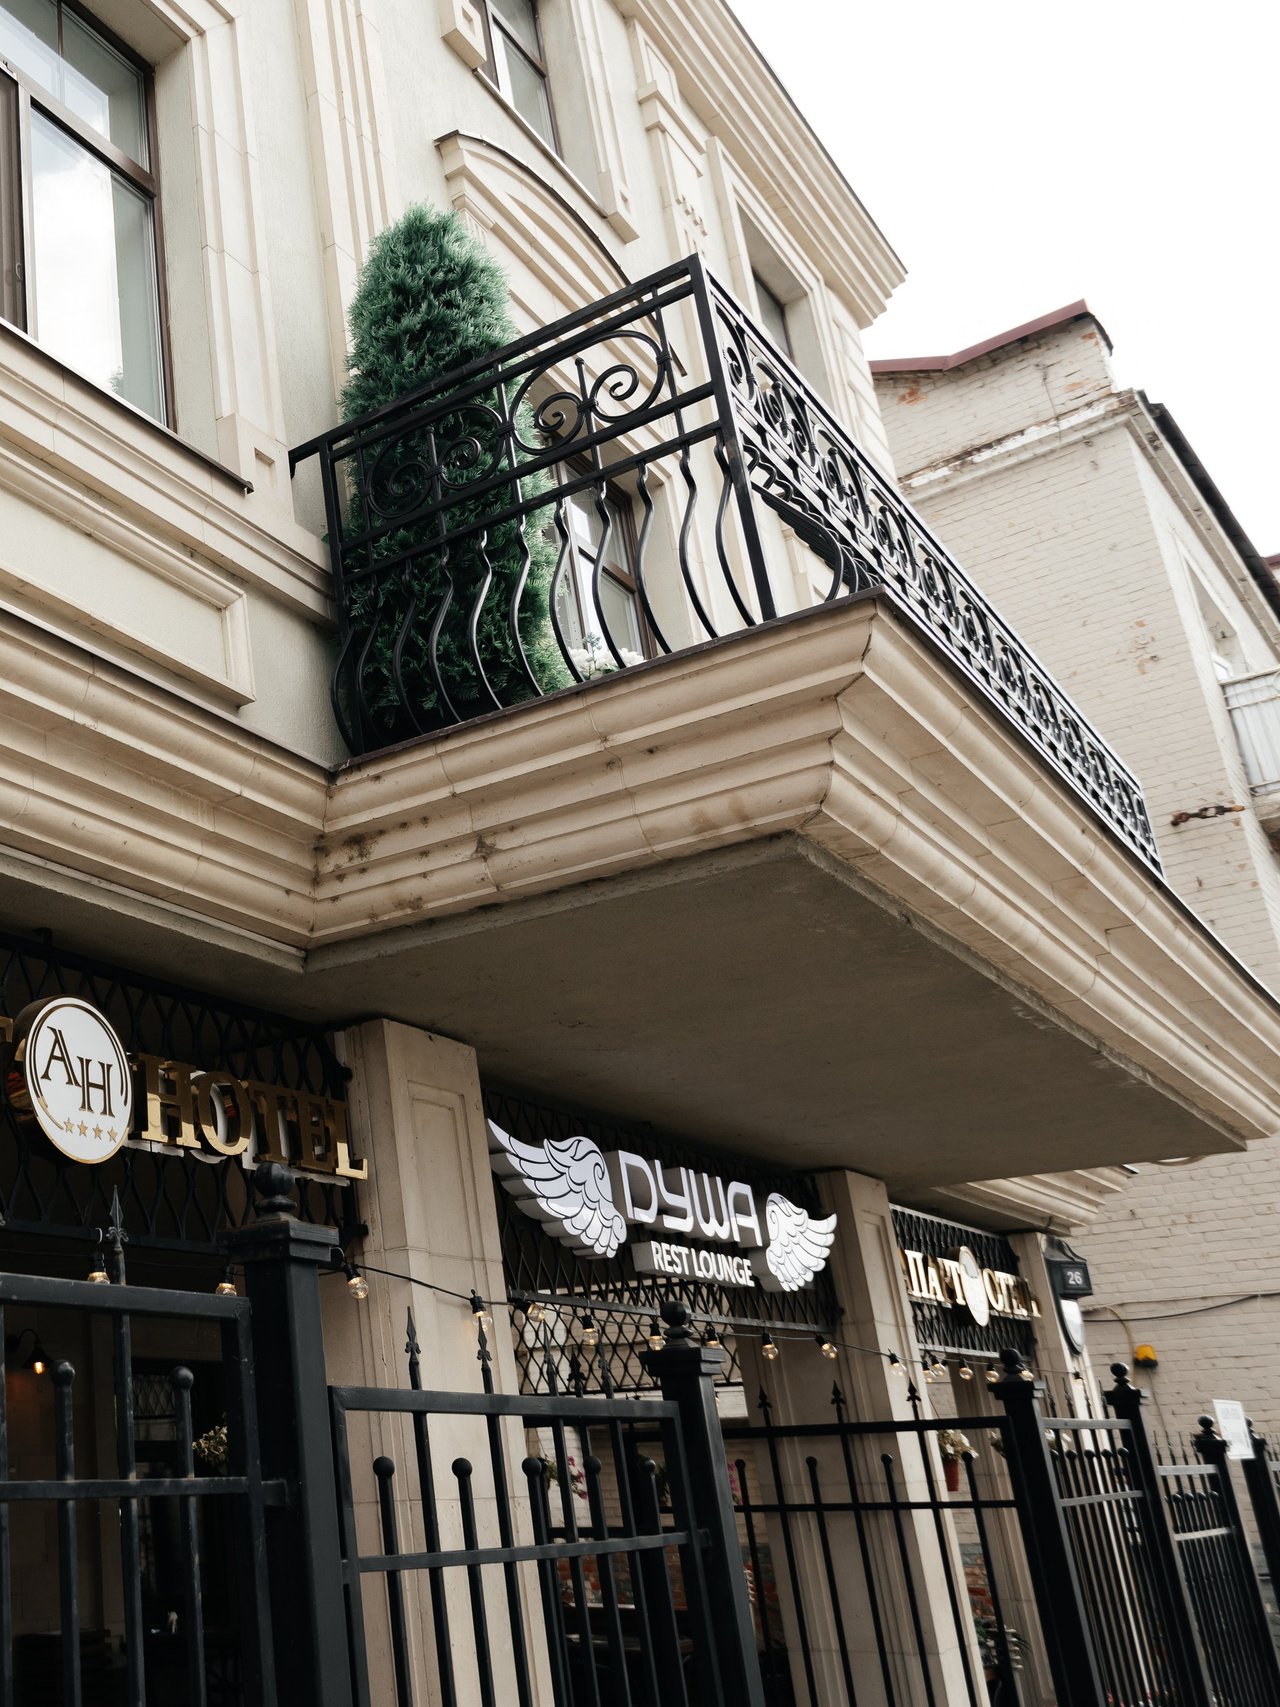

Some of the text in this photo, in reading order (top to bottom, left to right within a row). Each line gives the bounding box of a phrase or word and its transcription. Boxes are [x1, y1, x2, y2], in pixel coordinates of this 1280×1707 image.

[40, 1025, 116, 1118] AH
[133, 1053, 370, 1181] HOTEL
[617, 1149, 763, 1247] DYWA
[649, 1240, 756, 1288] REST LOUNGE
[1066, 1271, 1083, 1285] 26
